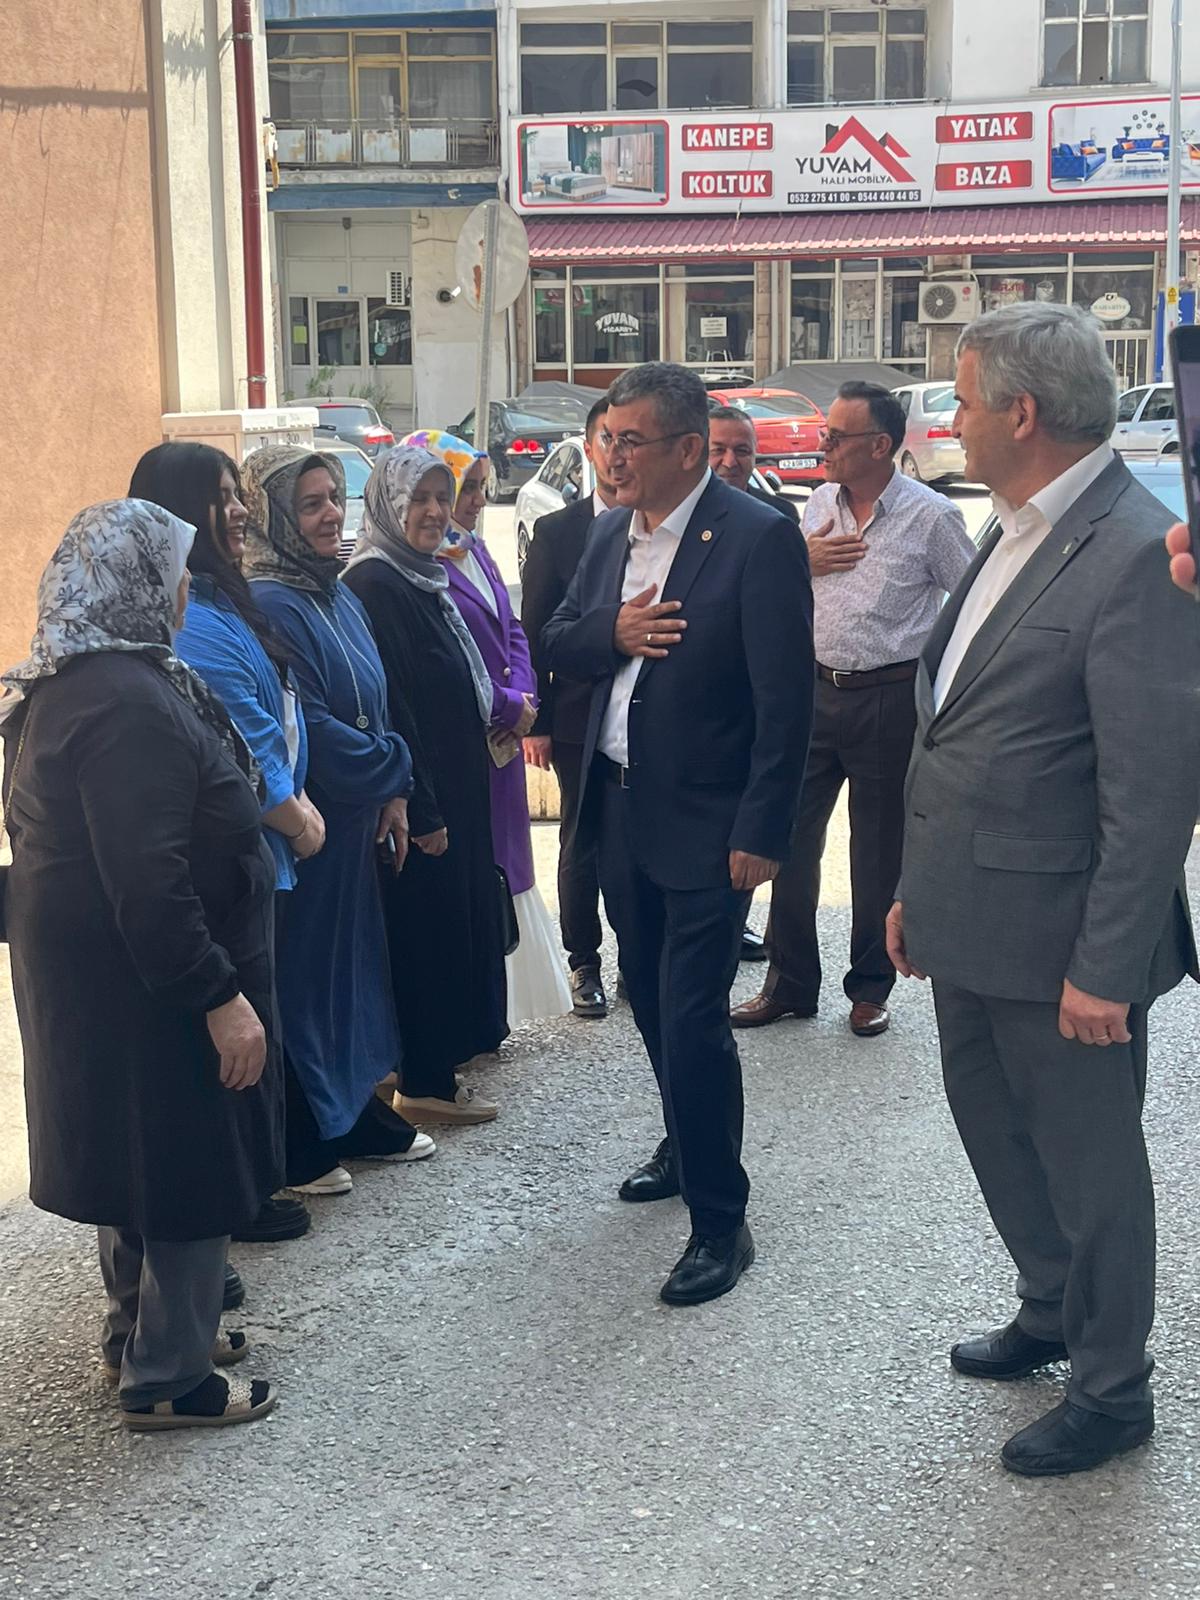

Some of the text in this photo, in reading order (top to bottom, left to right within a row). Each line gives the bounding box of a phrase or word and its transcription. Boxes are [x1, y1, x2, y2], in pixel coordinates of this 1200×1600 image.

[950, 117, 1018, 138] YATAK
[687, 128, 767, 147] KANEPE
[795, 157, 871, 174] YUVAM
[689, 174, 766, 193] KOLTUK
[821, 174, 893, 185] HALI MOBİLYA
[955, 165, 1012, 186] BAZA
[790, 193, 810, 203] 0532
[811, 193, 827, 202] 275
[828, 192, 838, 202] 41
[841, 192, 850, 202] 00
[858, 191, 878, 202] 0544
[896, 191, 907, 200] 44
[909, 190, 919, 200] 05
[594, 312, 639, 331] YUVAM
